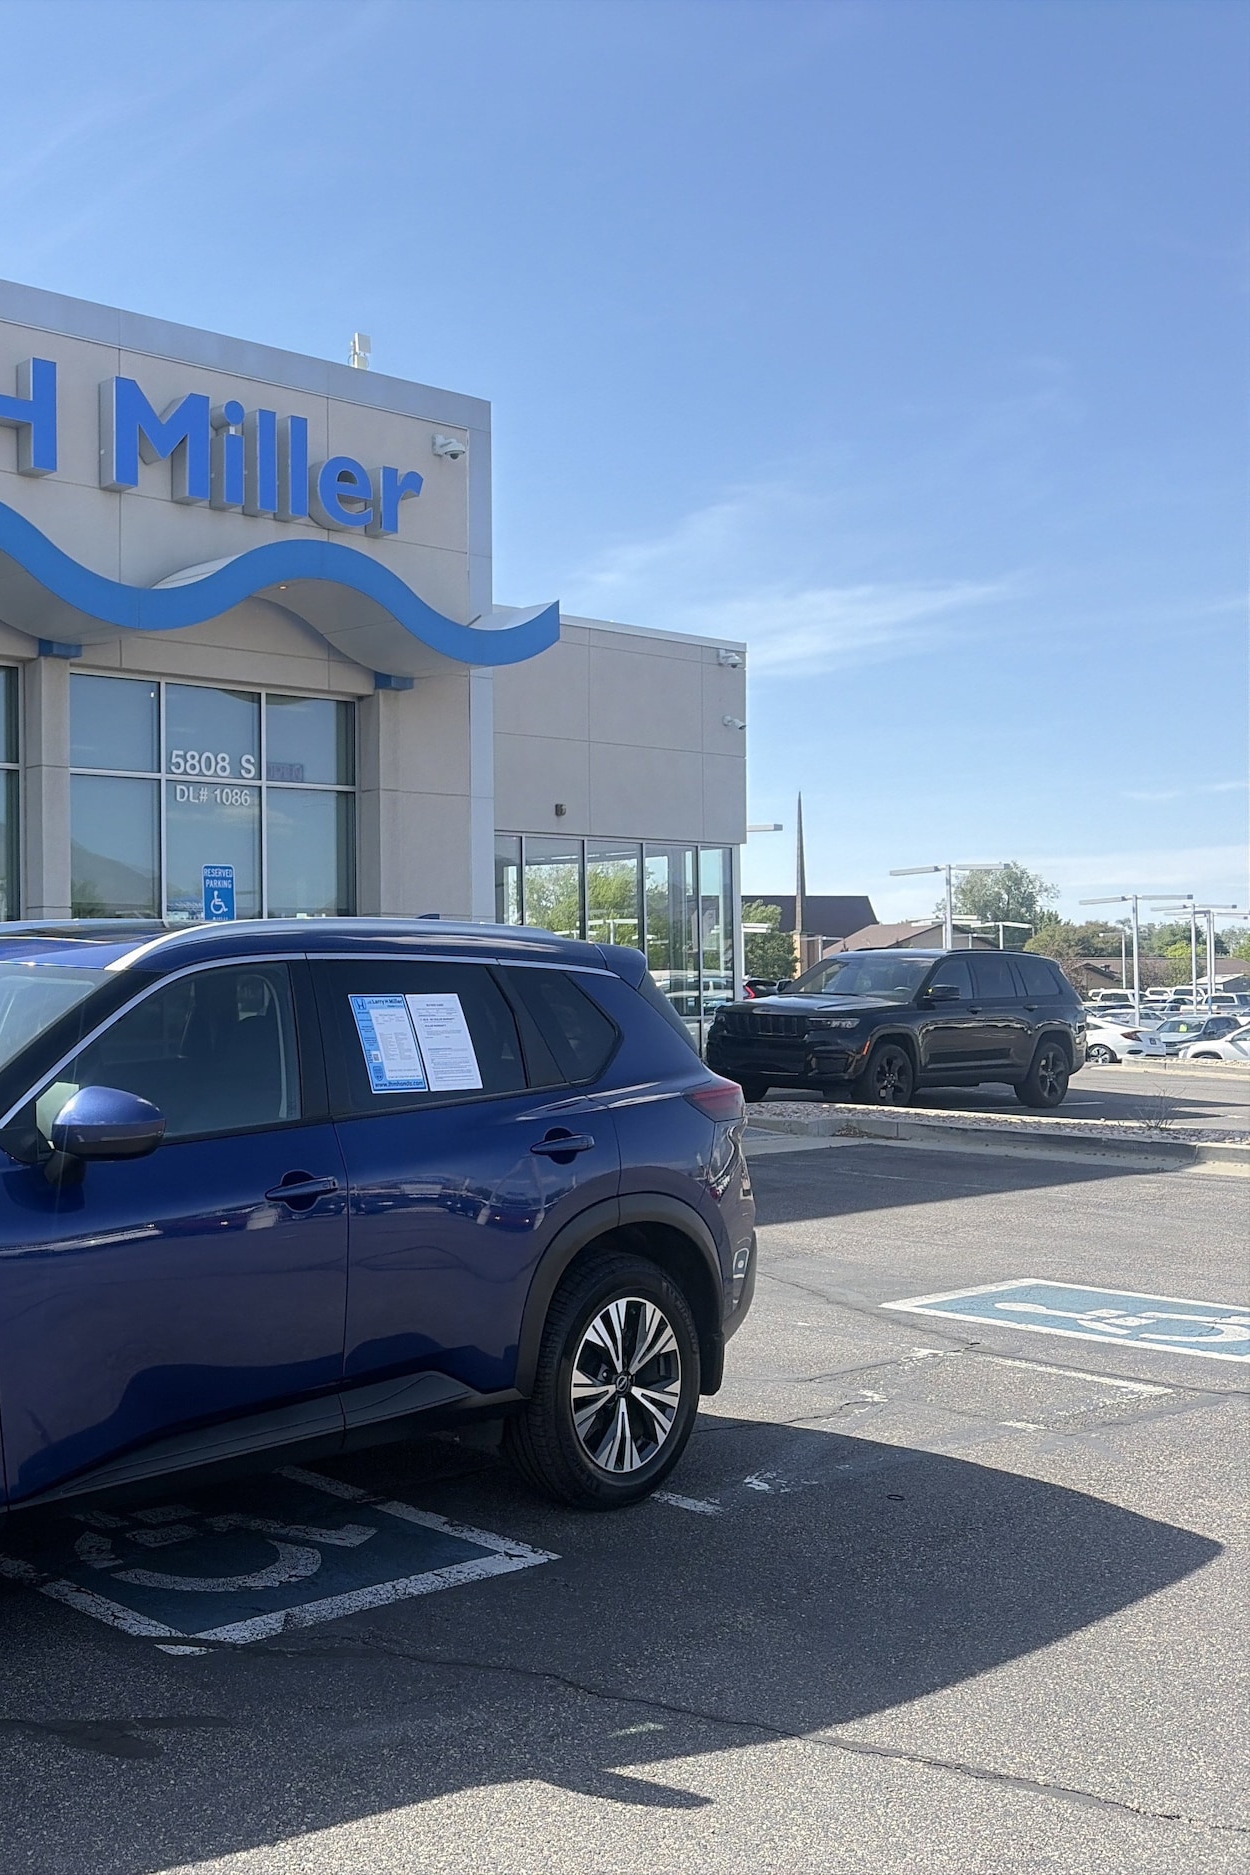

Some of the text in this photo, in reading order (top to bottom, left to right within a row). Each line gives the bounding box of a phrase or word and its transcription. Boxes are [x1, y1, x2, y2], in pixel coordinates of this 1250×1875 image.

[98, 375, 424, 538] Miller
[170, 750, 256, 779] 5808 S
[175, 785, 251, 806] DL# 1086
[203, 868, 233, 878] RESERVED
[205, 879, 232, 889] PARKING
